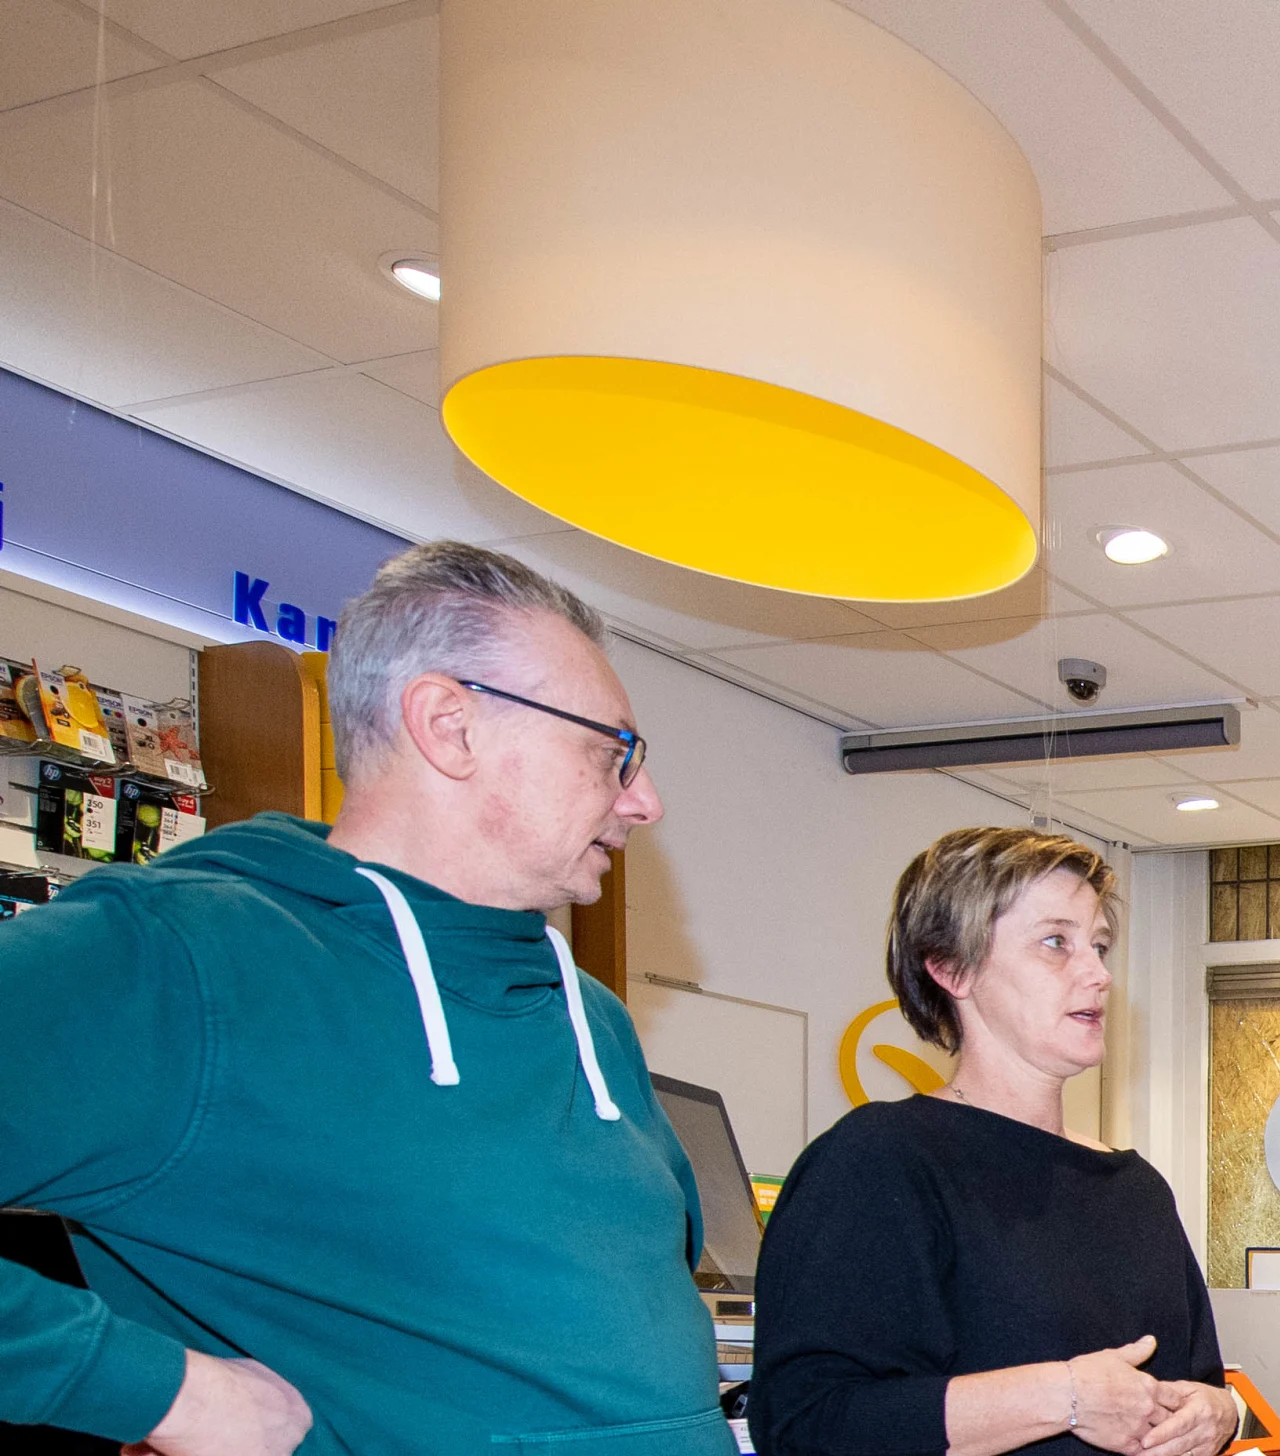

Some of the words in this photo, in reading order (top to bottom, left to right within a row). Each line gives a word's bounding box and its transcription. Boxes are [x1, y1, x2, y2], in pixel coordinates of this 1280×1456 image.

[128, 705, 154, 718] EPSON
[87, 799, 104, 809] 350
[86, 819, 101, 829] 351
